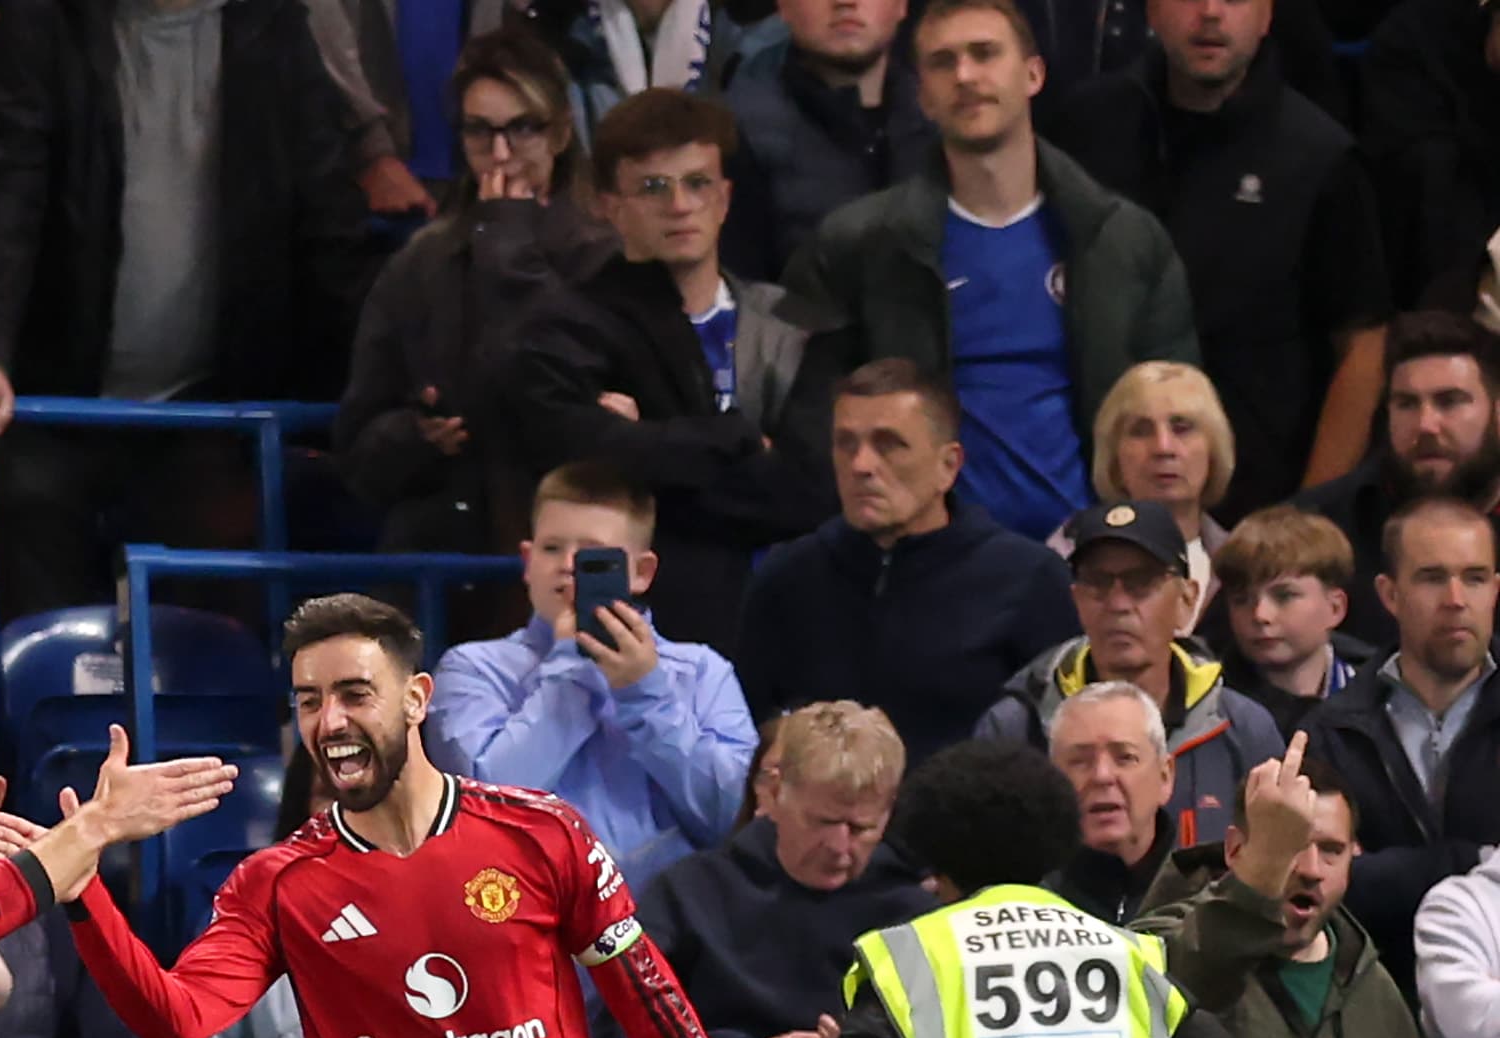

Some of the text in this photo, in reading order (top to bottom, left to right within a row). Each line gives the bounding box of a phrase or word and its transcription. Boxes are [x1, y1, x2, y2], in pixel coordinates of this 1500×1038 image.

[974, 906, 1086, 927] SAFETY
[965, 928, 1113, 953] STEWARD
[974, 958, 1121, 1030] 599
